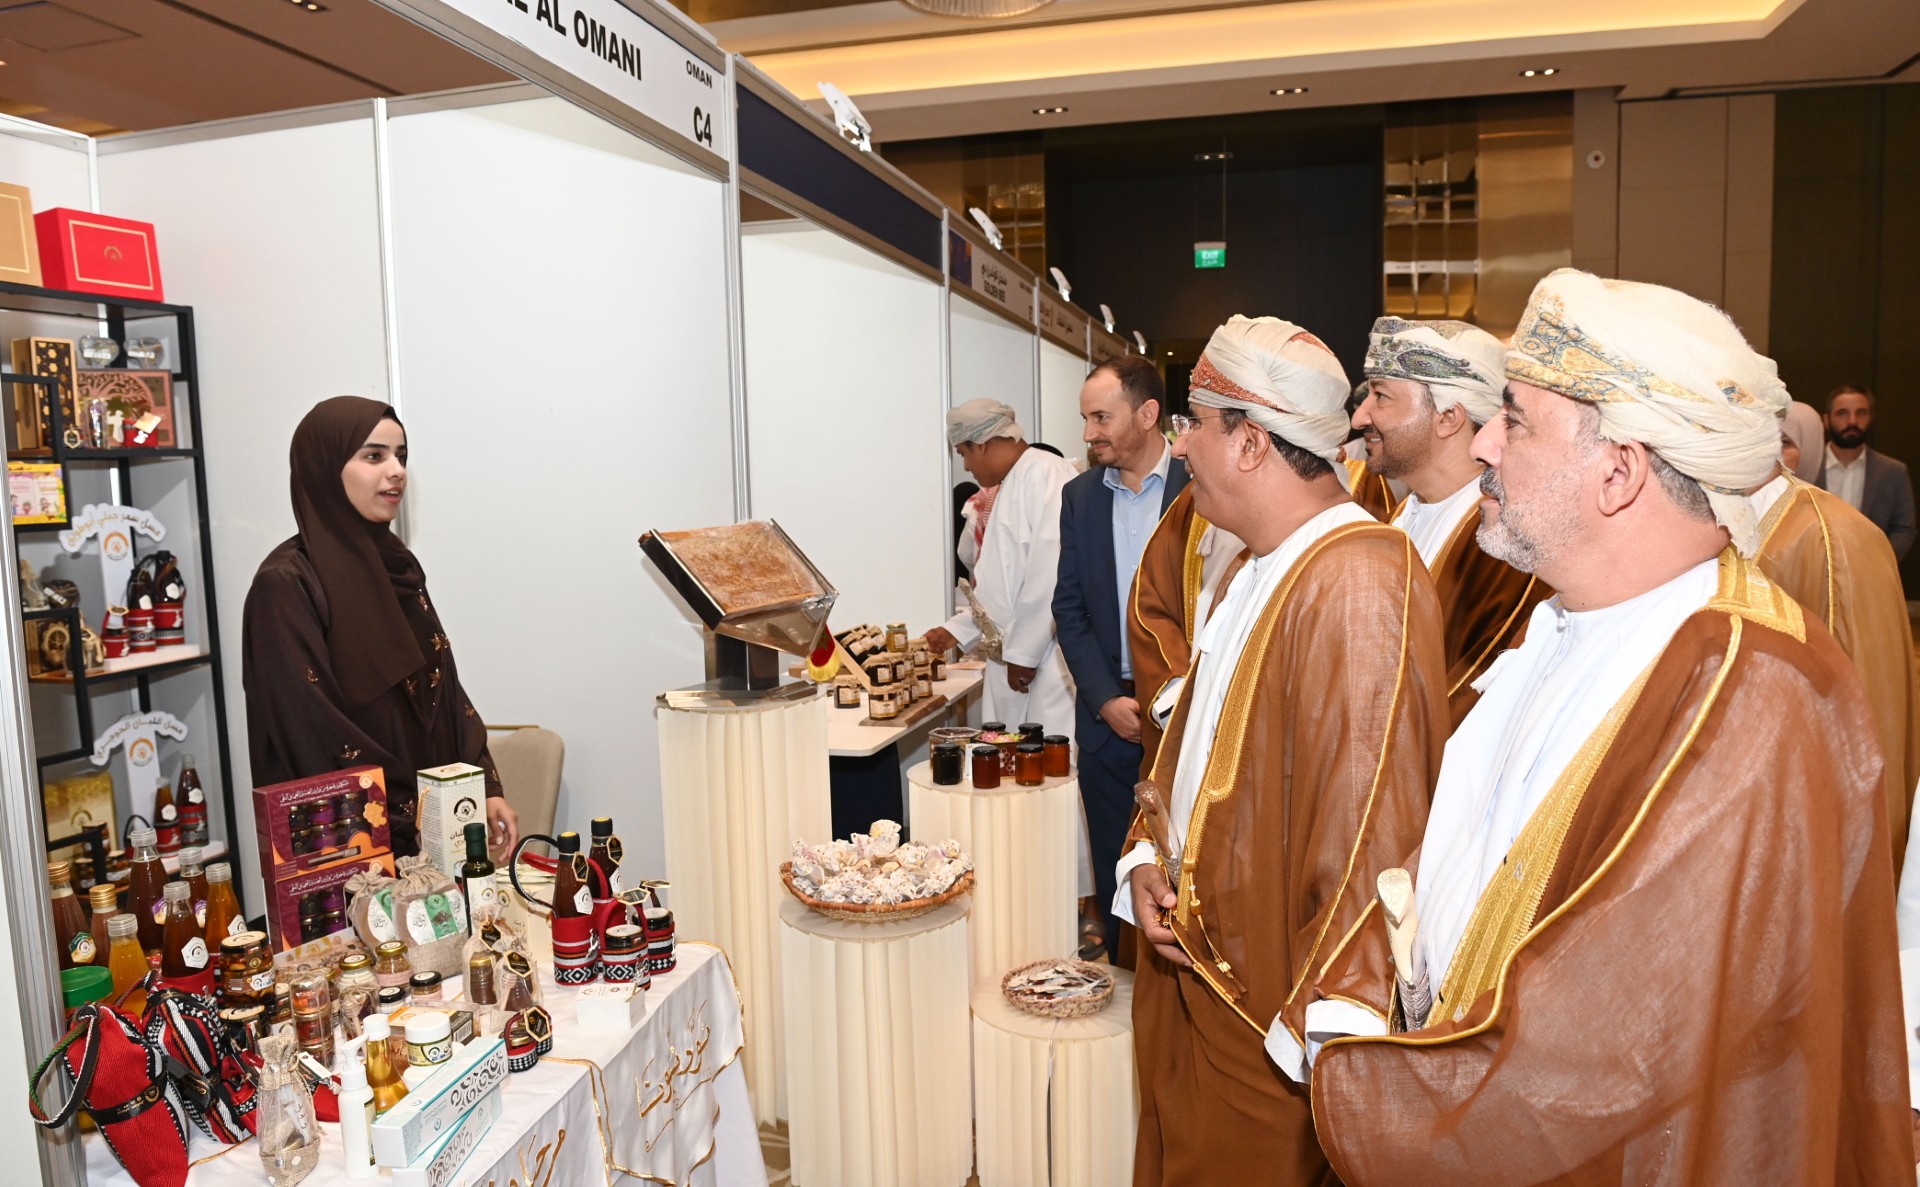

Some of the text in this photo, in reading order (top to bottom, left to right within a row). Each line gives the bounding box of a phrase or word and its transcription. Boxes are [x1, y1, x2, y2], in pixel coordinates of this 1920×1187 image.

[536, 0, 642, 81] AL OMANI
[686, 60, 713, 89] OMAN
[693, 106, 713, 148] C4
[163, 720, 183, 734] عسل
